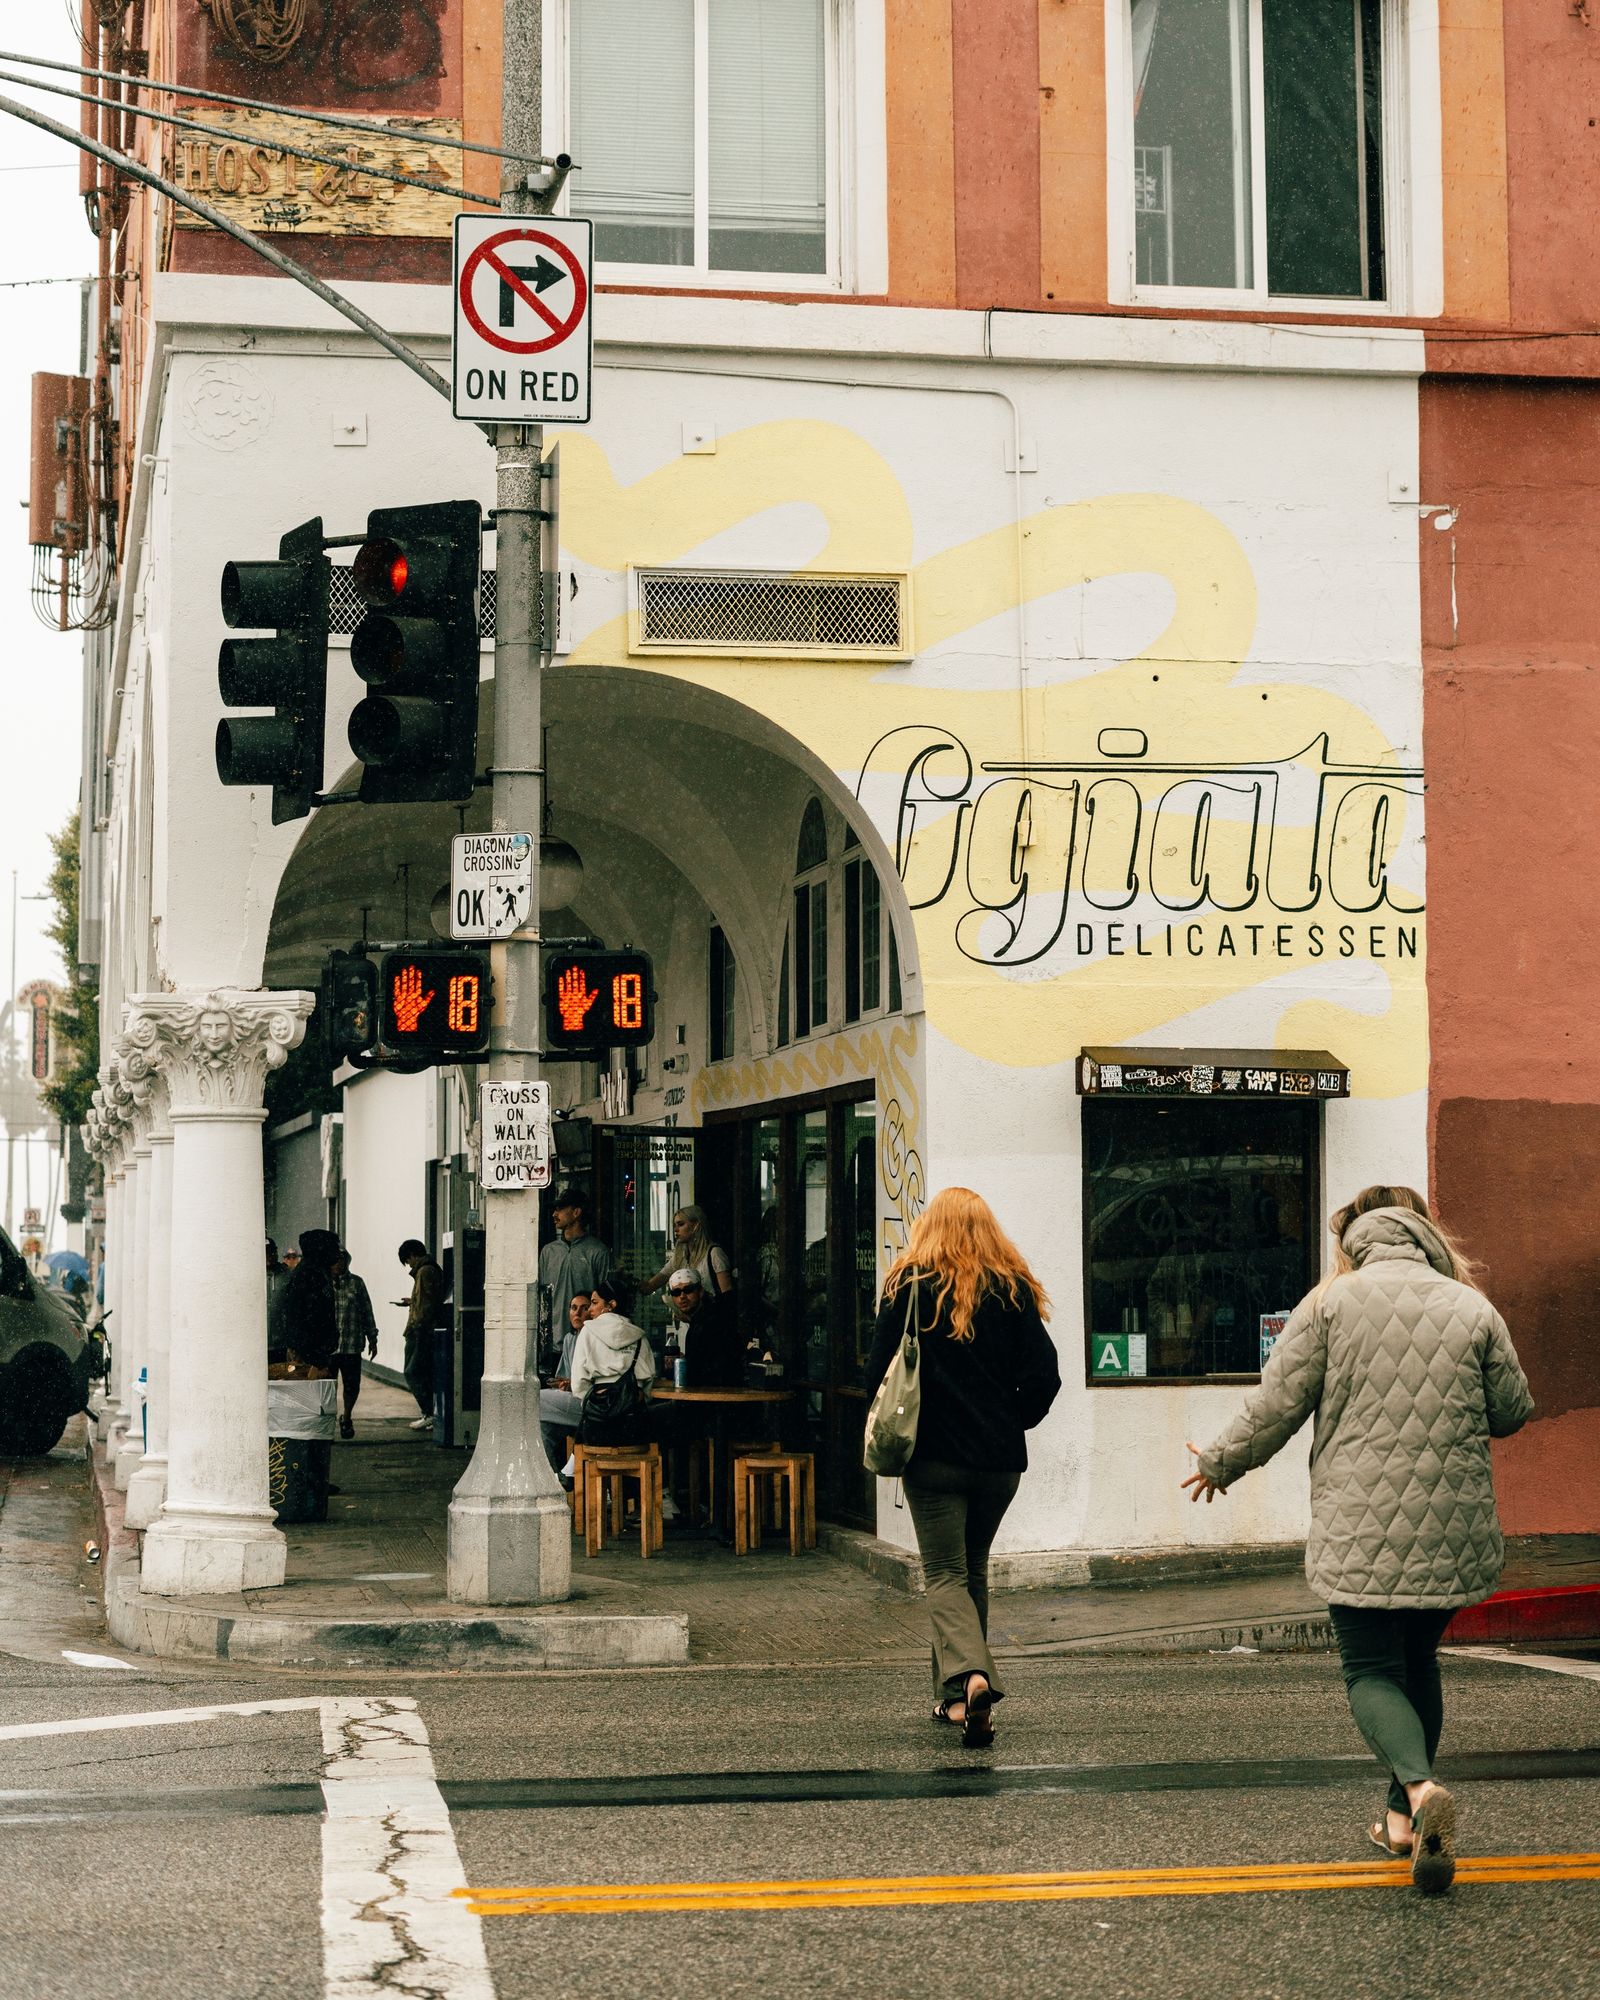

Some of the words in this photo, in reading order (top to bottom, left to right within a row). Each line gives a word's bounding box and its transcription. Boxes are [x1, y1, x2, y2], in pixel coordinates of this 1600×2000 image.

[181, 140, 374, 207] HOSTEL
[466, 368, 506, 400] ON
[520, 370, 579, 402] RED
[464, 838, 513, 855] DIAGONA
[463, 855, 520, 872] CROSSING
[457, 889, 485, 927] OK
[1077, 923, 1418, 958] DELICATESSEN
[449, 975, 479, 1032] 18
[612, 973, 641, 1028] 18
[1245, 1070, 1277, 1082] CANS
[1318, 1073, 1339, 1090] CMB
[1248, 1080, 1273, 1091] MTA
[507, 1108, 523, 1120] ON
[495, 1125, 536, 1140] WALK
[496, 1165, 535, 1180] ONLY
[1098, 1342, 1122, 1369] A
